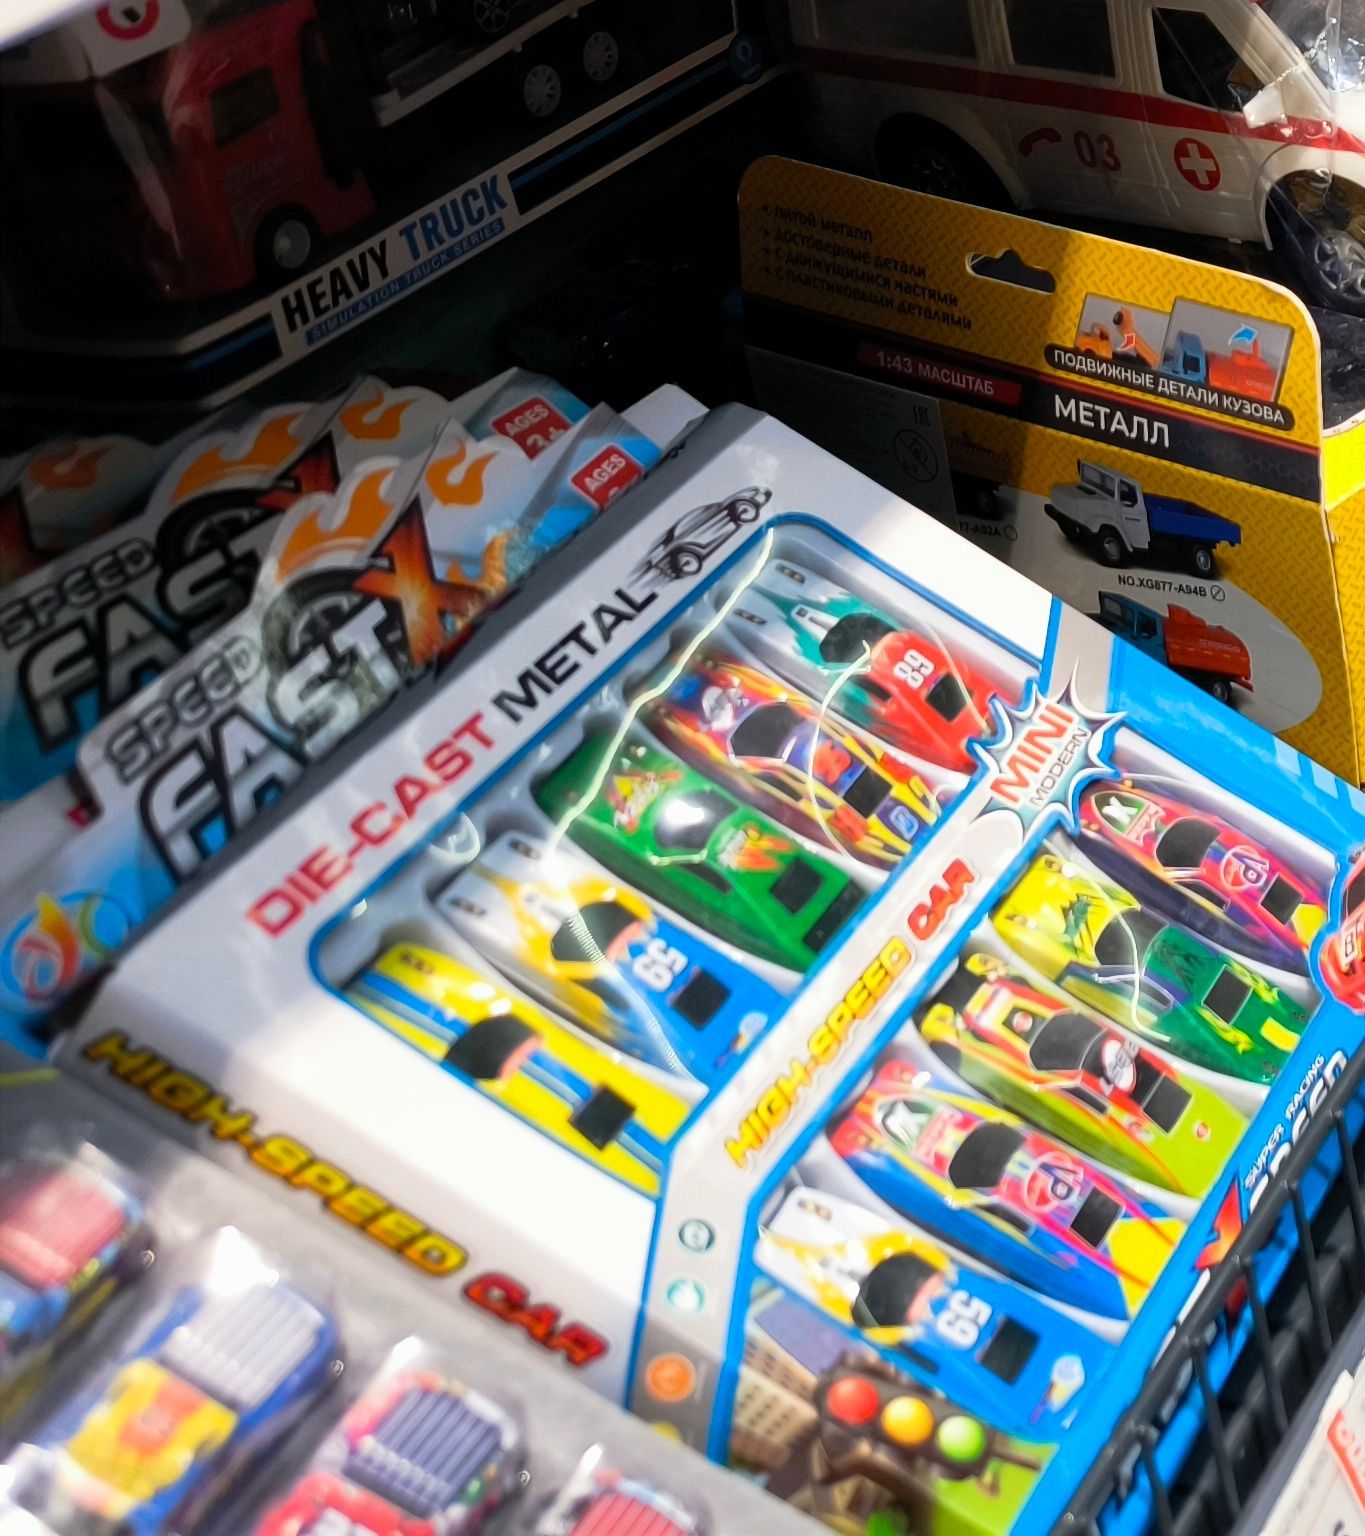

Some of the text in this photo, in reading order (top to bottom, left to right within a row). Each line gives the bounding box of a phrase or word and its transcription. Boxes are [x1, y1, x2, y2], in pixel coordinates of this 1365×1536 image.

[1073, 129, 1122, 172] 03
[281, 173, 509, 333] HEAVY TRUCK
[310, 275, 405, 344] SIMULATION
[452, 218, 504, 261] SERIES
[874, 254, 928, 280] детали
[896, 279, 959, 309] частями
[896, 301, 973, 331] деталями
[875, 348, 995, 397] 1:43 МАСШТАБ
[1053, 349, 1286, 426] ПОДВИЖНЫЕ ДЕТАЛИ КУЗОВА
[504, 403, 550, 437] AGES
[1053, 393, 1171, 449] МЕТАЛЛ
[583, 453, 627, 494] AGES
[1, 536, 156, 650] SPEED
[107, 635, 264, 785] SPEED
[139, 596, 404, 881] FAST
[989, 703, 1075, 805] MINI
[246, 586, 659, 939] DIE-CAST METAL
[1028, 727, 1092, 807] MODERN
[723, 855, 978, 1168] HIGH-SPEED CAR
[1244, 1054, 1326, 1188] SUPER RACING
[83, 1030, 611, 1369] HIGH-SPEED CAR
